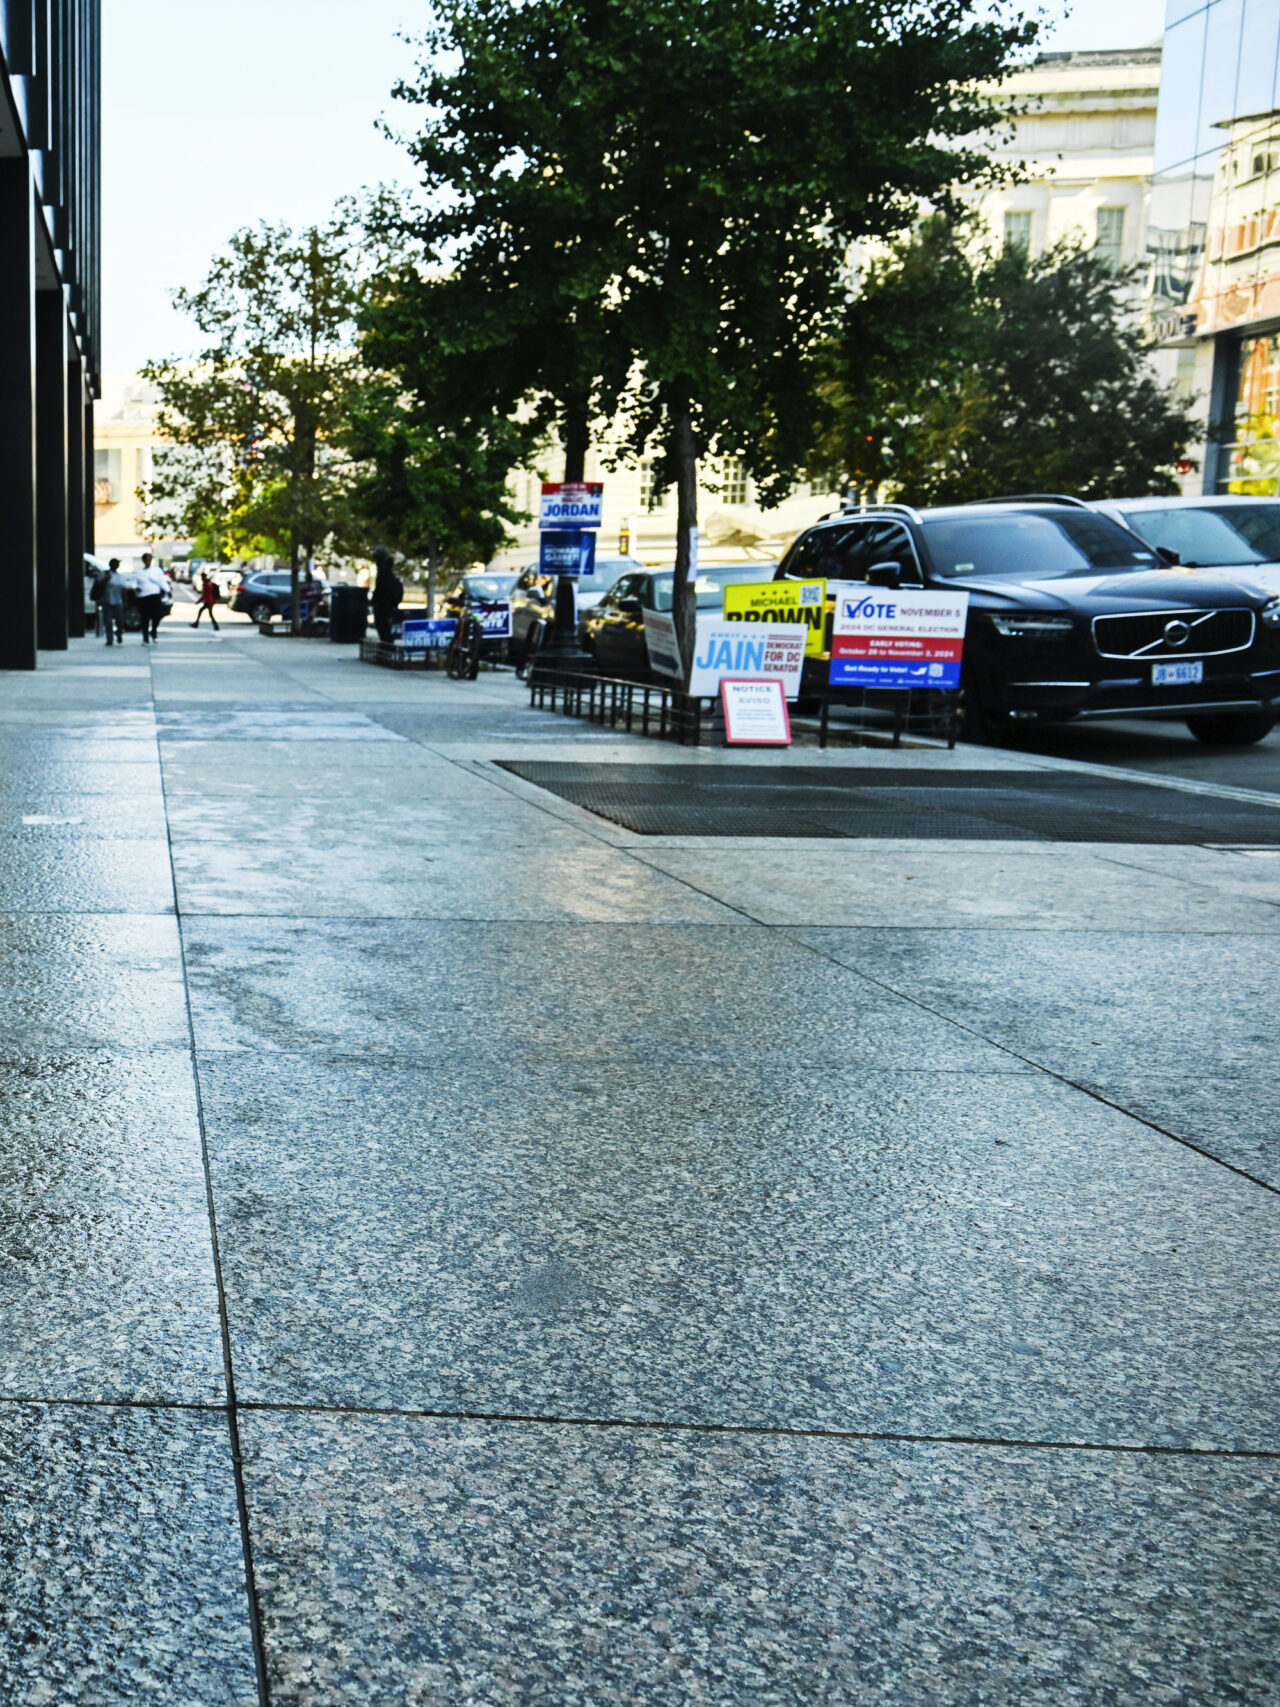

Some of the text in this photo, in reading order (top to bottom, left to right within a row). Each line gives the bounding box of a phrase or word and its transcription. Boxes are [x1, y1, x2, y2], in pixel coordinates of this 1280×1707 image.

[543, 504, 600, 517] JORDAN
[750, 597, 798, 607] MICHAEL
[846, 596, 961, 618] VOTE NOVEMBER 5
[877, 624, 914, 632] GENERAL
[767, 642, 802, 650] DEMOCRAT
[869, 640, 893, 648] EARLY
[696, 639, 764, 672] JAIN
[765, 651, 801, 662] FOR DC
[934, 650, 954, 658] 2024
[763, 664, 799, 672] SENATOR
[844, 664, 858, 672] Get
[858, 664, 880, 674] Ready
[732, 686, 773, 694] NOTICE
